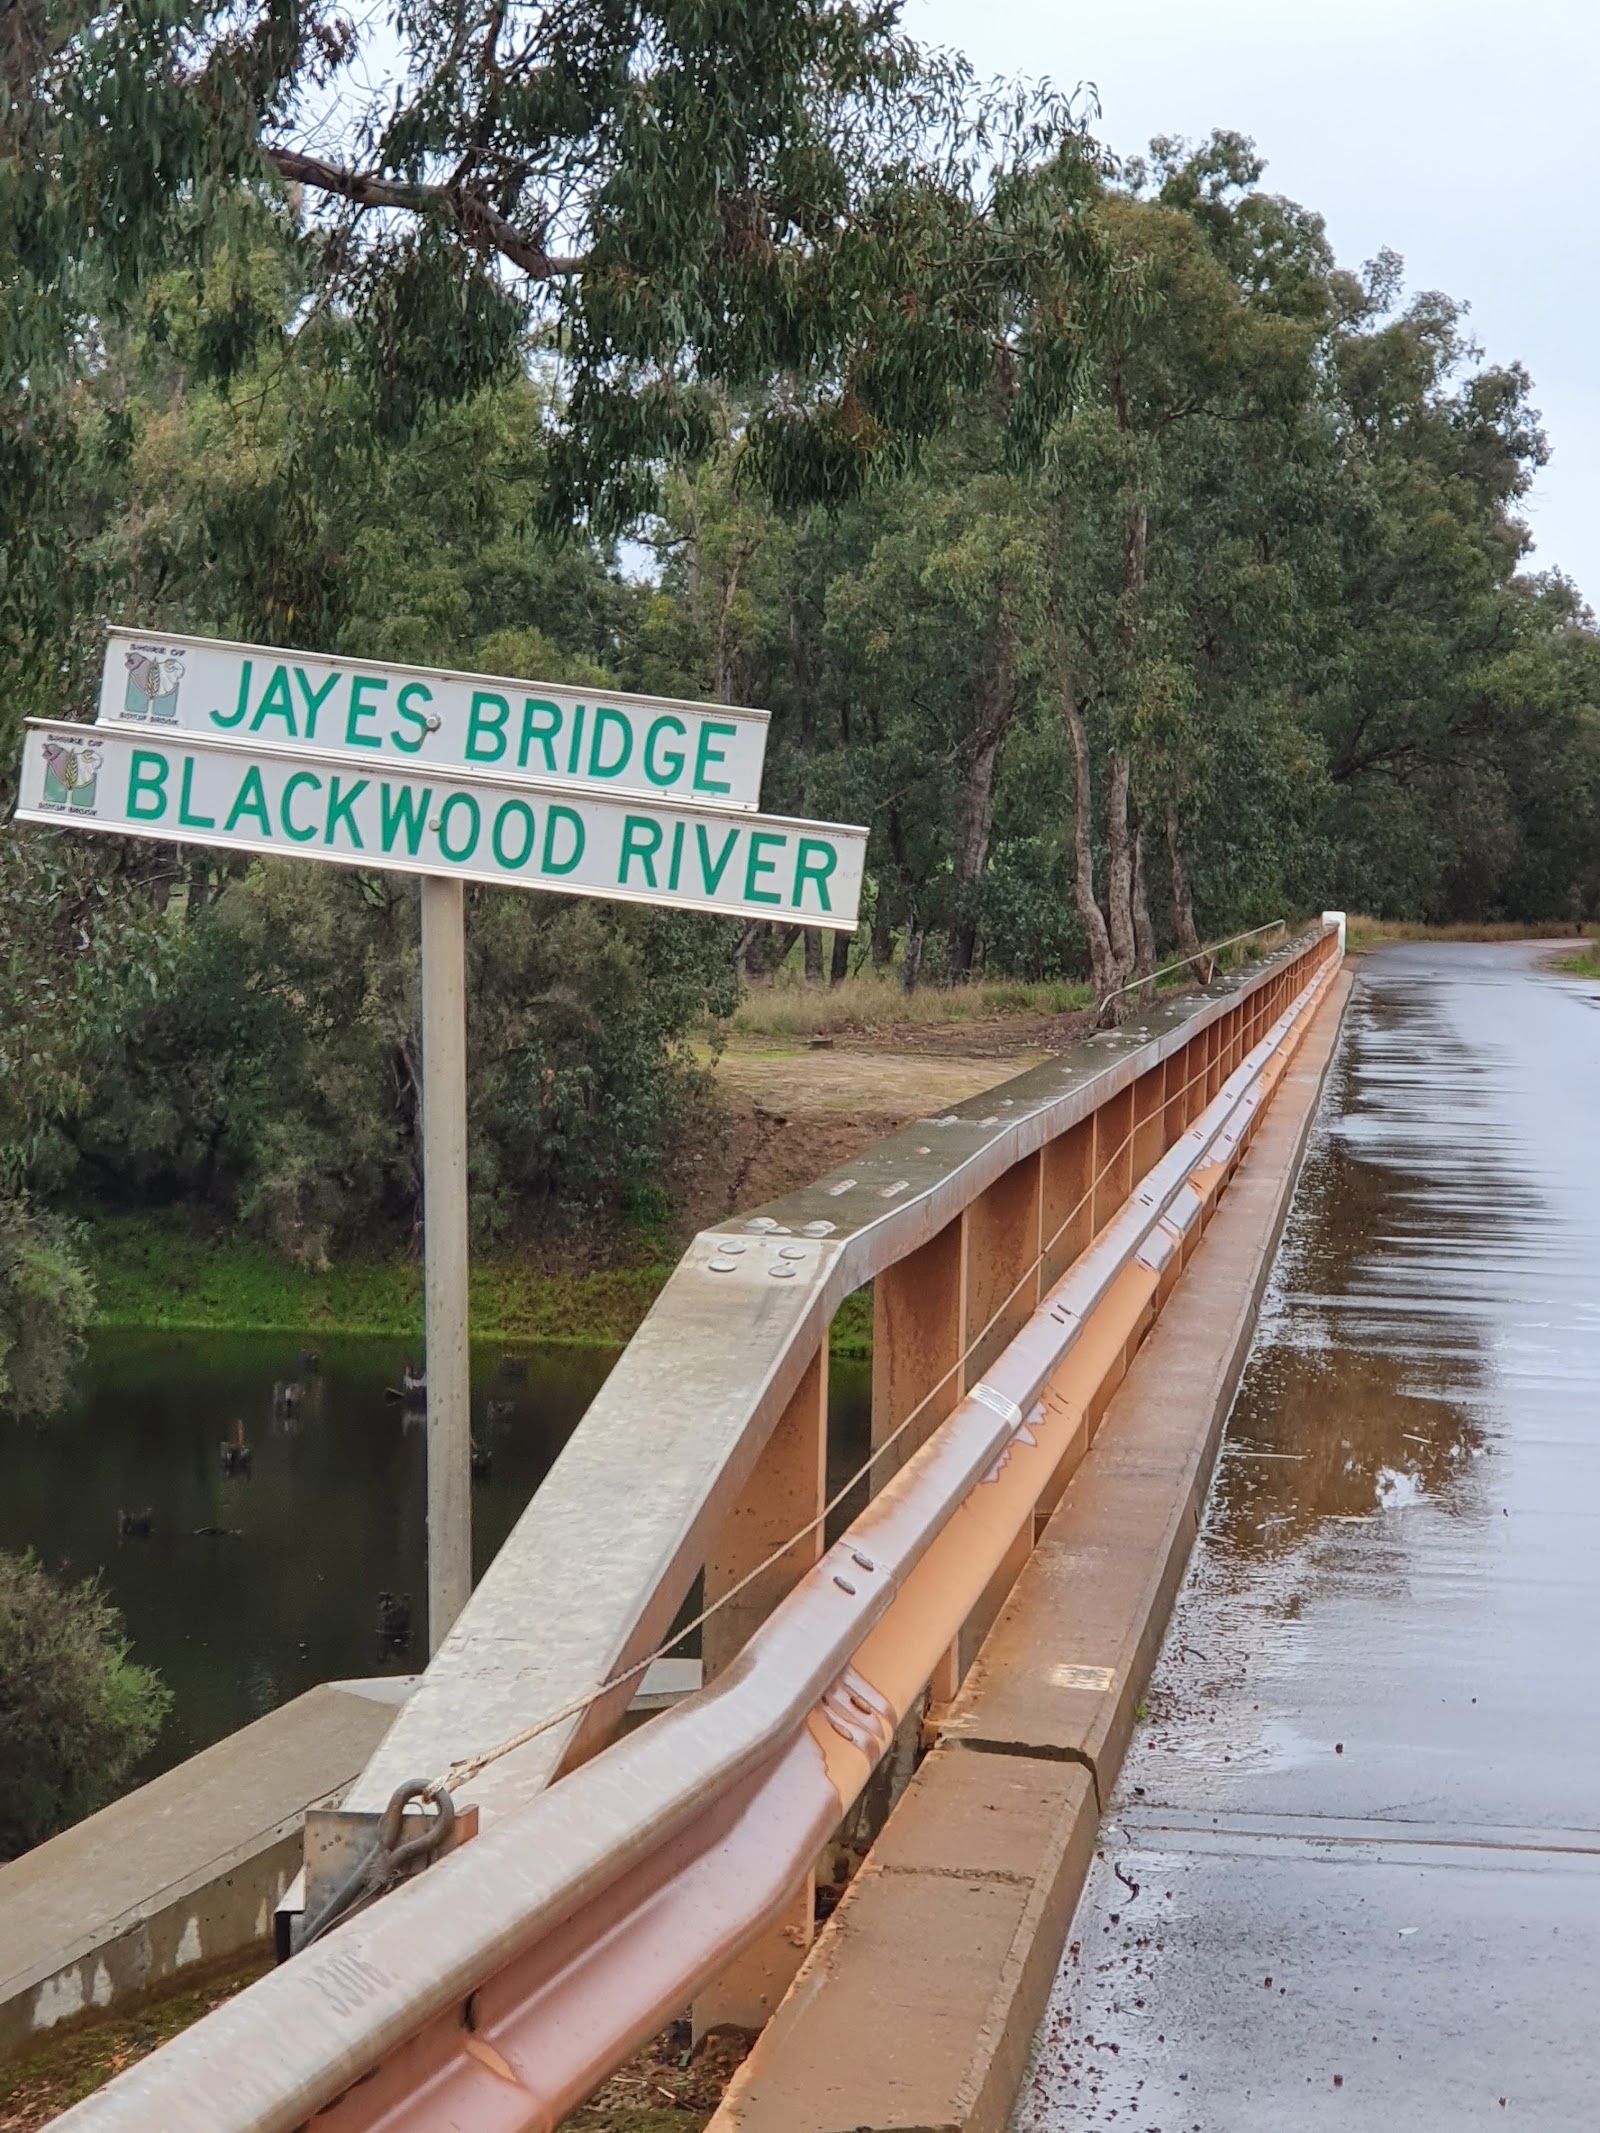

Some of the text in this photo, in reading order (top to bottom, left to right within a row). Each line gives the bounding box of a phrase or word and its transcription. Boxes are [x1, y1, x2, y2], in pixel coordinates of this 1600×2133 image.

[210, 661, 737, 794] JAYES BRIDGE
[126, 750, 837, 911] BLACKWOOD RIVER
